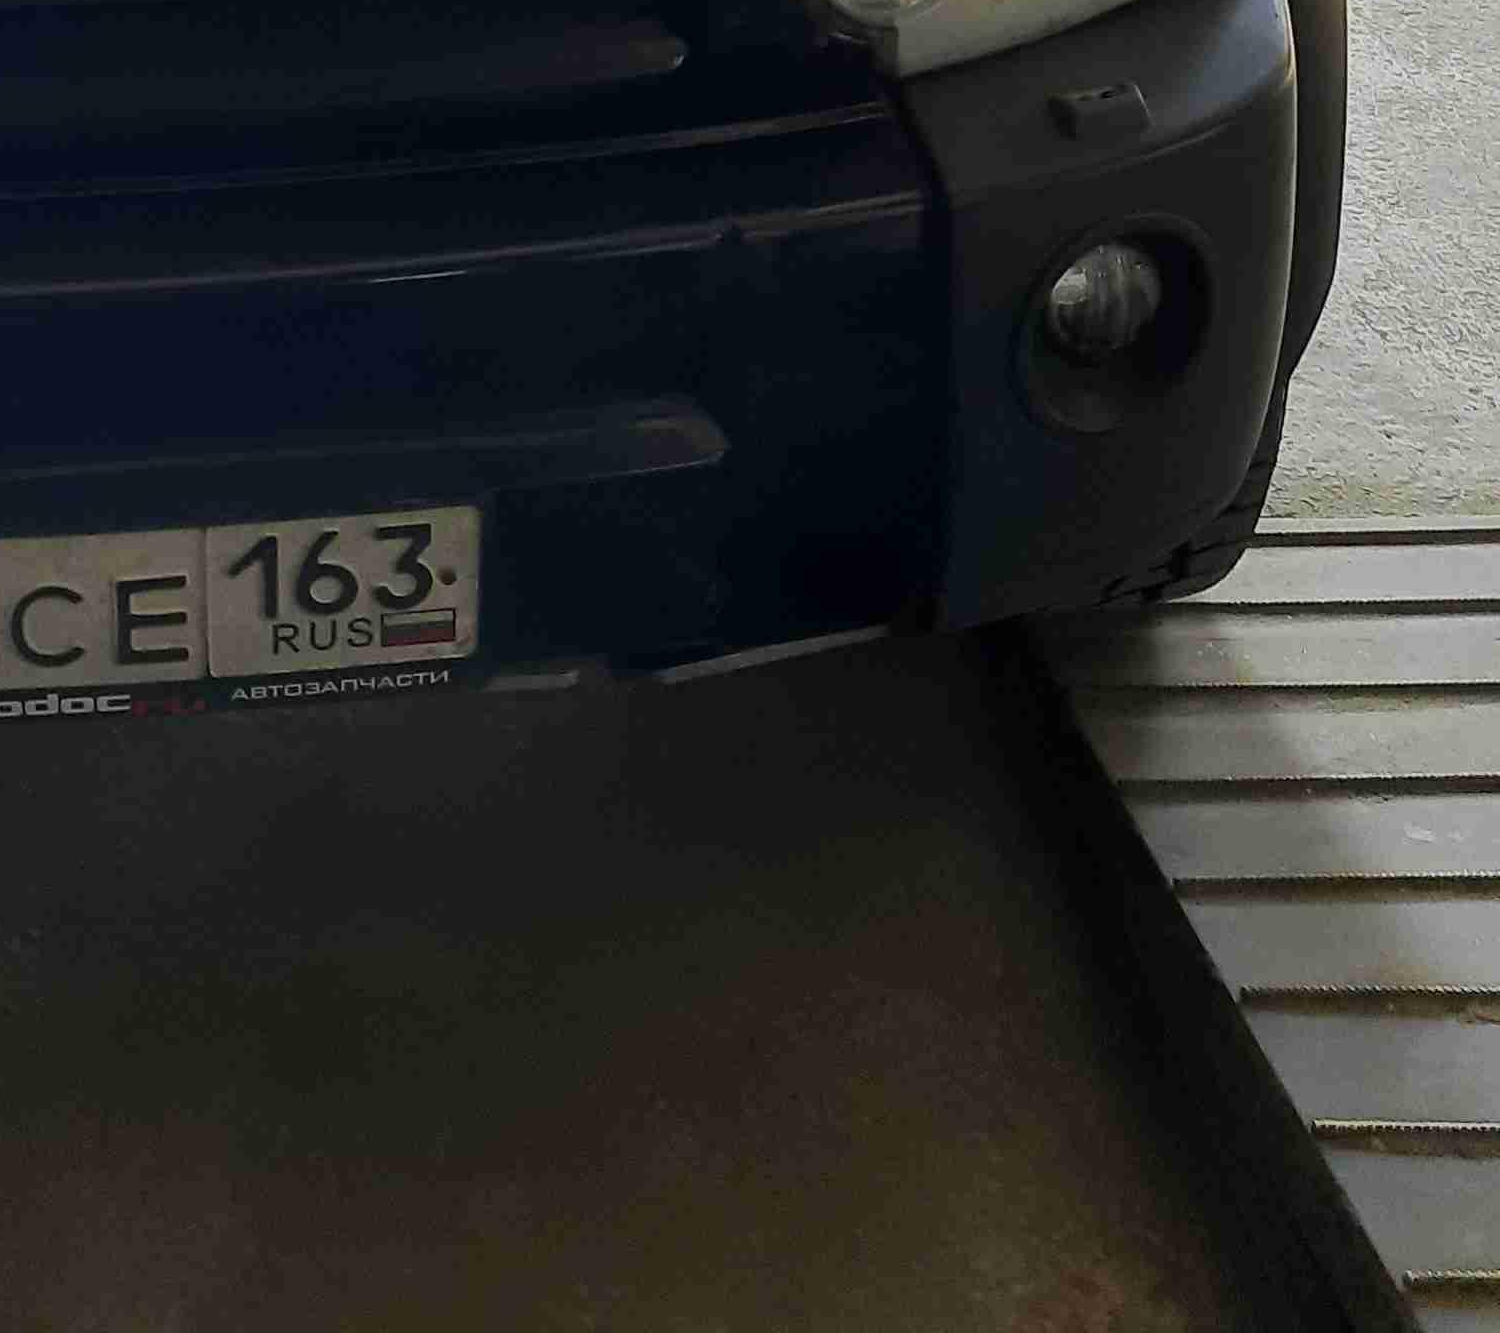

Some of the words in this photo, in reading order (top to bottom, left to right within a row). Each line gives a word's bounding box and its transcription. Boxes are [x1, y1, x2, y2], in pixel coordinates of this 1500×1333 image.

[226, 522, 435, 620] 163
[272, 617, 373, 655] RUS
[230, 669, 451, 701] АВТОЗАПЧАСТИ
